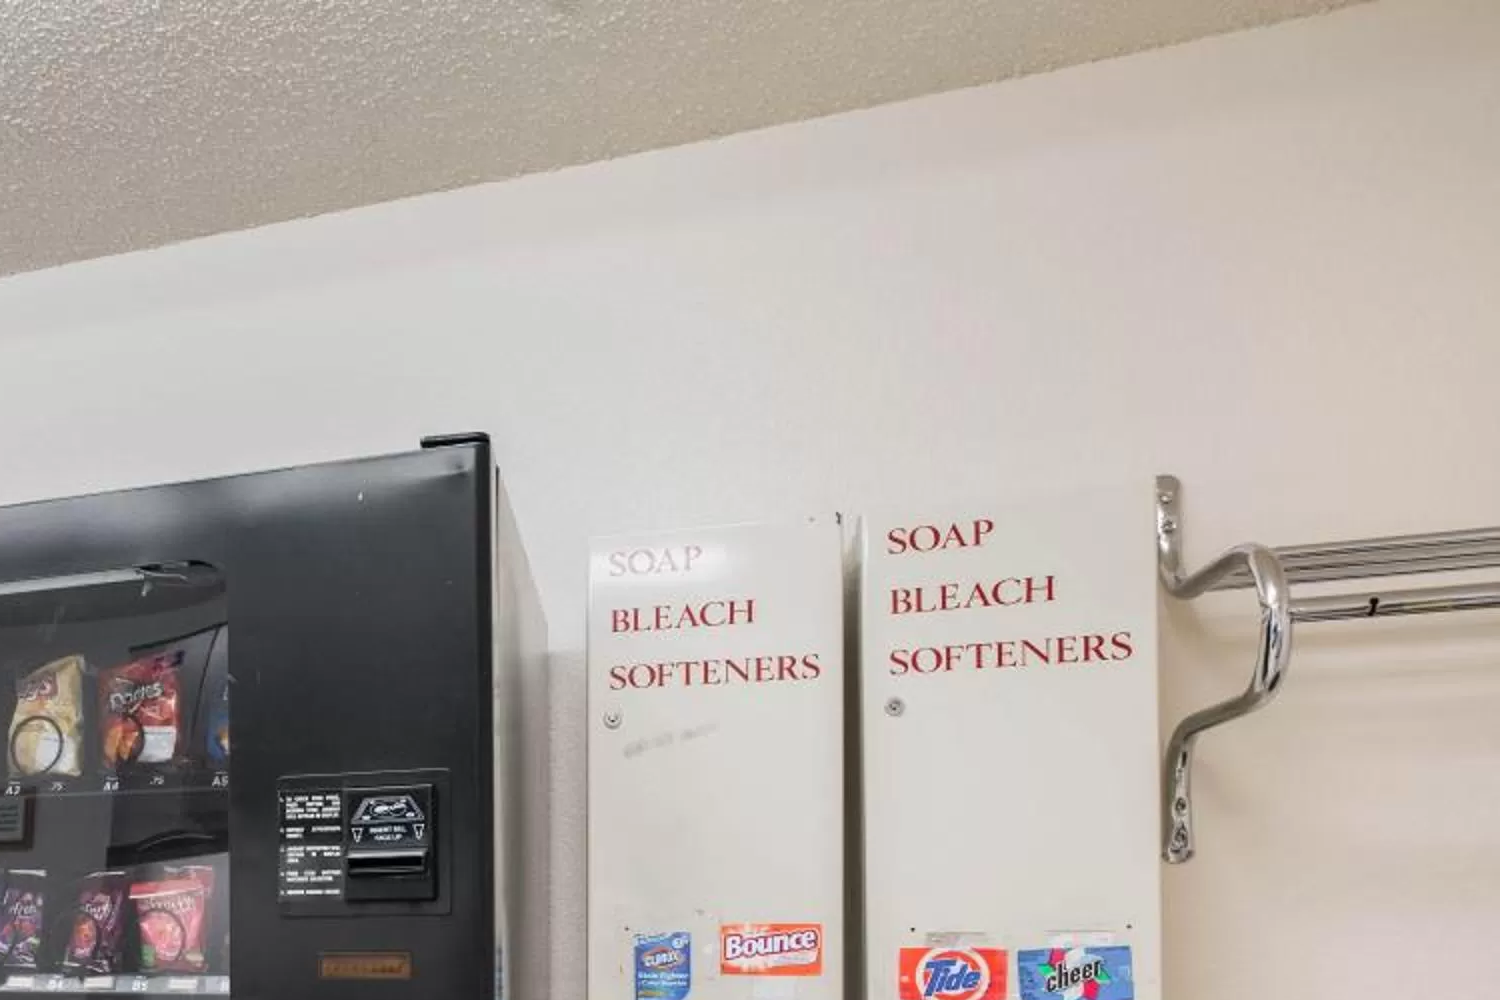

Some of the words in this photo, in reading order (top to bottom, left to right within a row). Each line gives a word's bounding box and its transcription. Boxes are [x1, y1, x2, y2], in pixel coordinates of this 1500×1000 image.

[887, 518, 995, 555] SOAP
[608, 545, 703, 577] SOAP
[890, 575, 1056, 615] BLEACH
[612, 600, 756, 633] BLEACH
[609, 653, 821, 690] SOFTENERS
[889, 631, 1134, 676] SOFTENERS
[724, 929, 818, 962] Bounce
[924, 960, 982, 997] Tide
